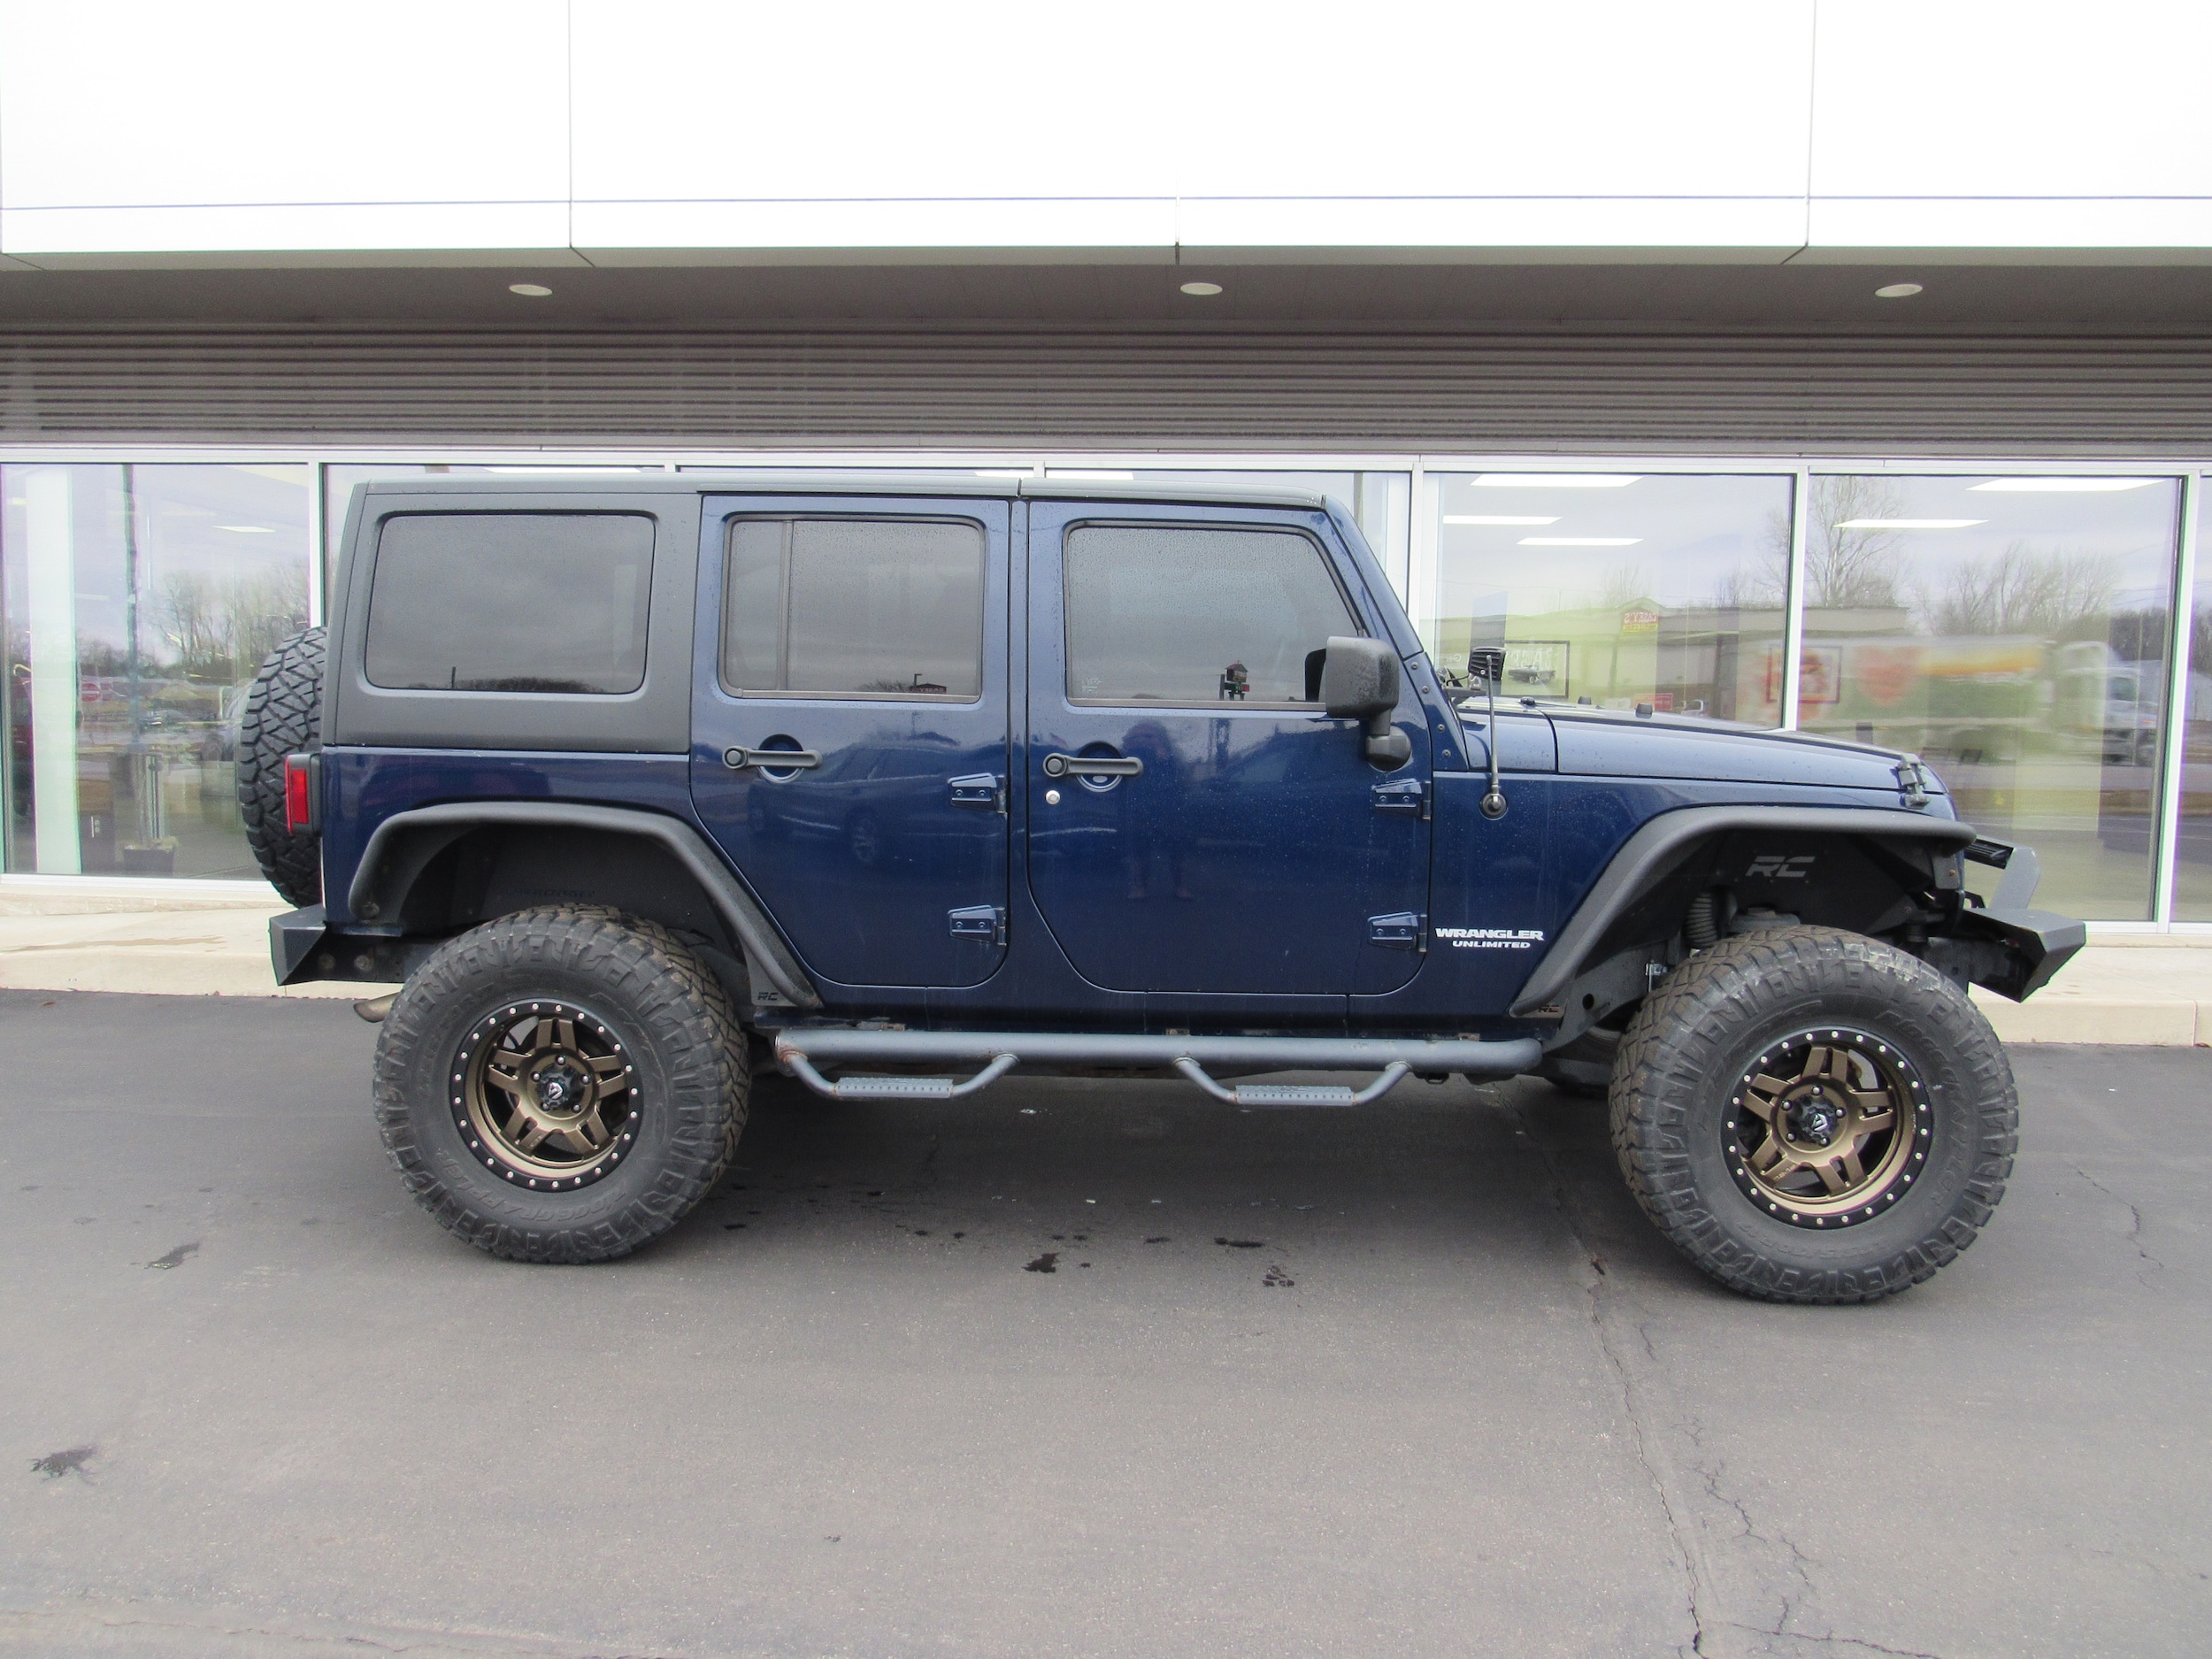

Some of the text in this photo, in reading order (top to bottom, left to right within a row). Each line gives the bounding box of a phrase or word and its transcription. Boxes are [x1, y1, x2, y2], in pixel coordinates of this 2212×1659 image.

[1745, 856, 1816, 878] RC
[1435, 927, 1545, 941] WRANGLER
[1452, 940, 1531, 949] UNLIMITED
[757, 992, 779, 1001] RC
